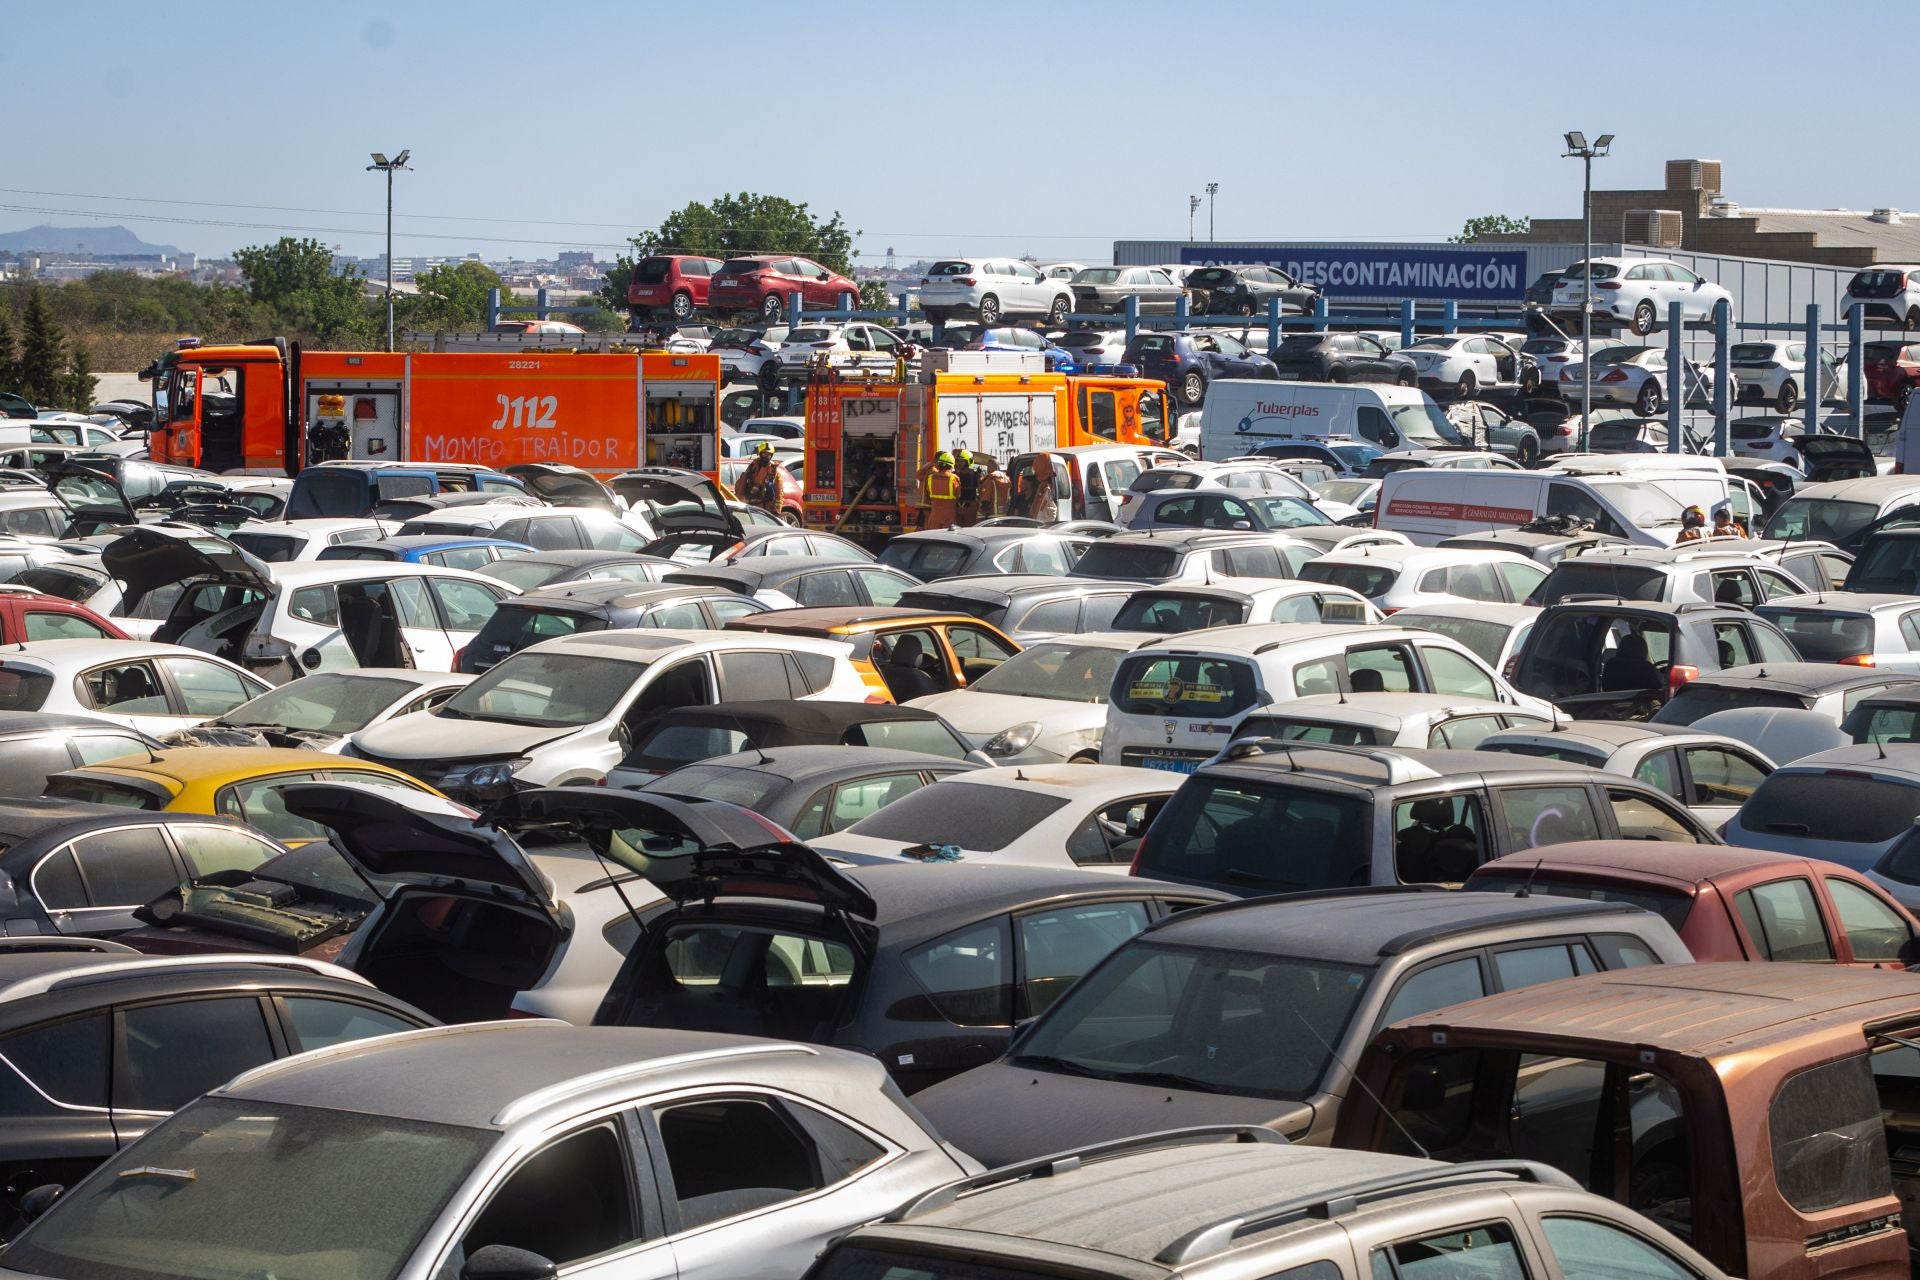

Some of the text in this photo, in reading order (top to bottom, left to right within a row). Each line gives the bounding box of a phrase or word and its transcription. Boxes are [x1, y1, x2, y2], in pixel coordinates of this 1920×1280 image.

[1288, 257, 1517, 289] DESCONTAMINACIÓN
[509, 361, 541, 369] 28221
[510, 395, 558, 429] 112
[984, 409, 1030, 430] BOMBERS
[1256, 401, 1320, 418] Tuberplas
[946, 410, 969, 434] PP
[424, 434, 504, 461] MOMPO
[997, 431, 1015, 447] EN
